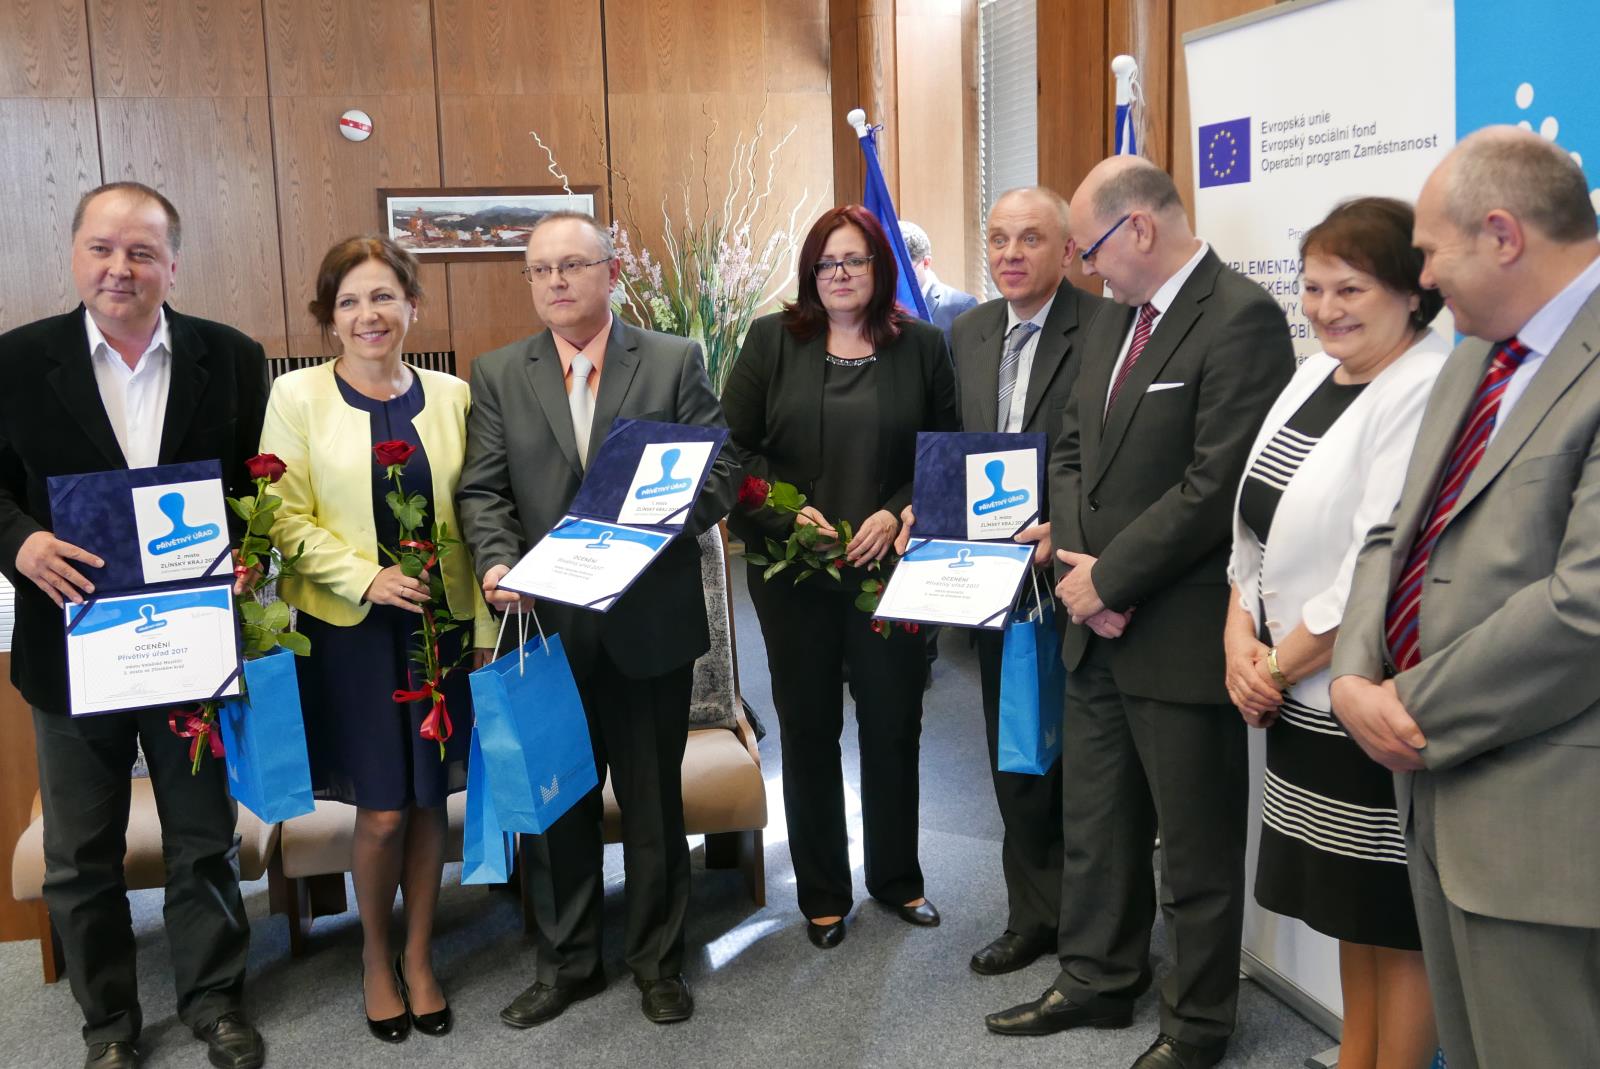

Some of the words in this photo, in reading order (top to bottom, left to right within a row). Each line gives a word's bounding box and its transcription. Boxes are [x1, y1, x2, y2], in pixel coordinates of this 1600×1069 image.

[1261, 113, 1306, 135] Evropská
[1308, 109, 1331, 126] unie
[1261, 132, 1305, 153] Evropský
[1308, 126, 1350, 146] sociální
[1352, 121, 1377, 139] fond
[1261, 153, 1304, 173] Operační
[1306, 148, 1351, 168] program
[1354, 133, 1438, 159] Zaměstnanost
[155, 533, 192, 551] PŘÍVĚTIVÝ
[192, 529, 213, 541] ÚŘAD
[187, 558, 203, 566] KRAJ
[134, 640, 171, 652] OCENĚNÍ
[171, 647, 188, 655] 2017
